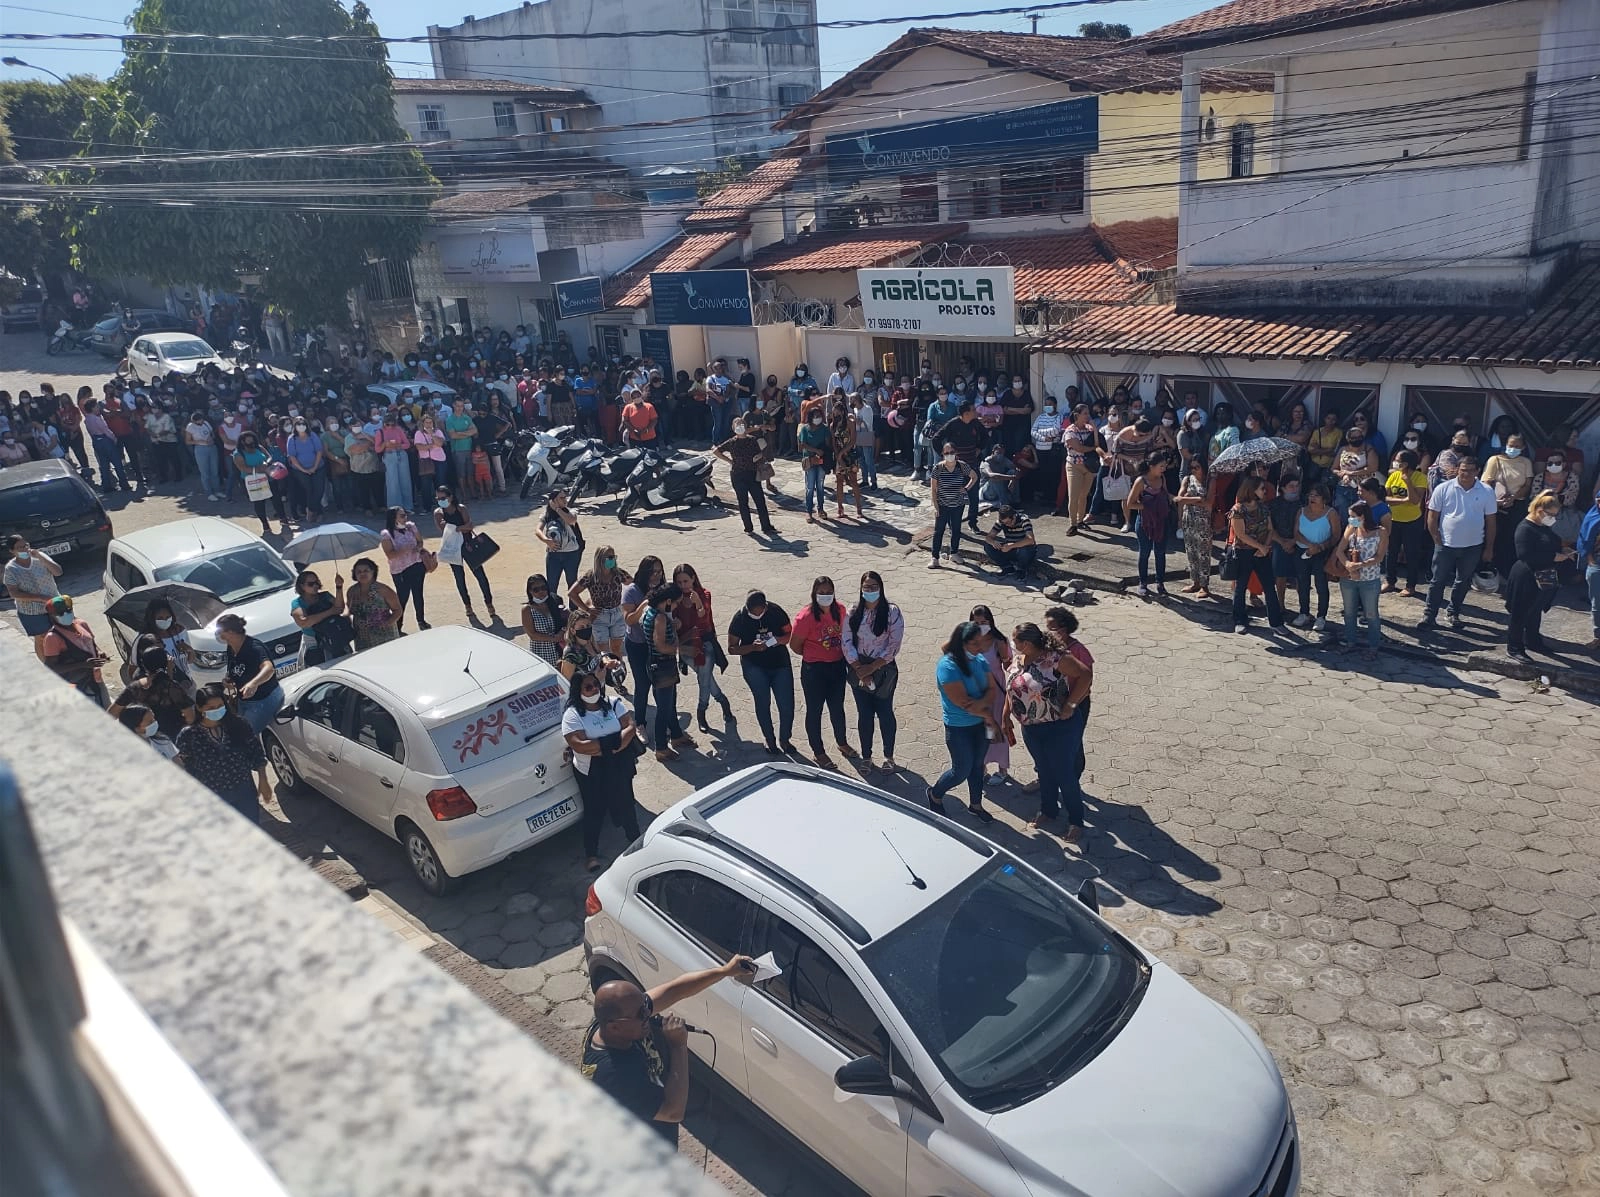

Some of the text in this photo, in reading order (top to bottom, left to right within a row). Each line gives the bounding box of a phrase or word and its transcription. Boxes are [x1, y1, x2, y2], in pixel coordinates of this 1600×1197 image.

[870, 270, 995, 301] AGRÍCOLA
[687, 295, 749, 310] CONVIVENDO
[938, 304, 996, 316] PROJETOS
[867, 318, 921, 330] 27 99978-2707
[1142, 373, 1155, 384] 77
[531, 802, 572, 830] RBE7E84
